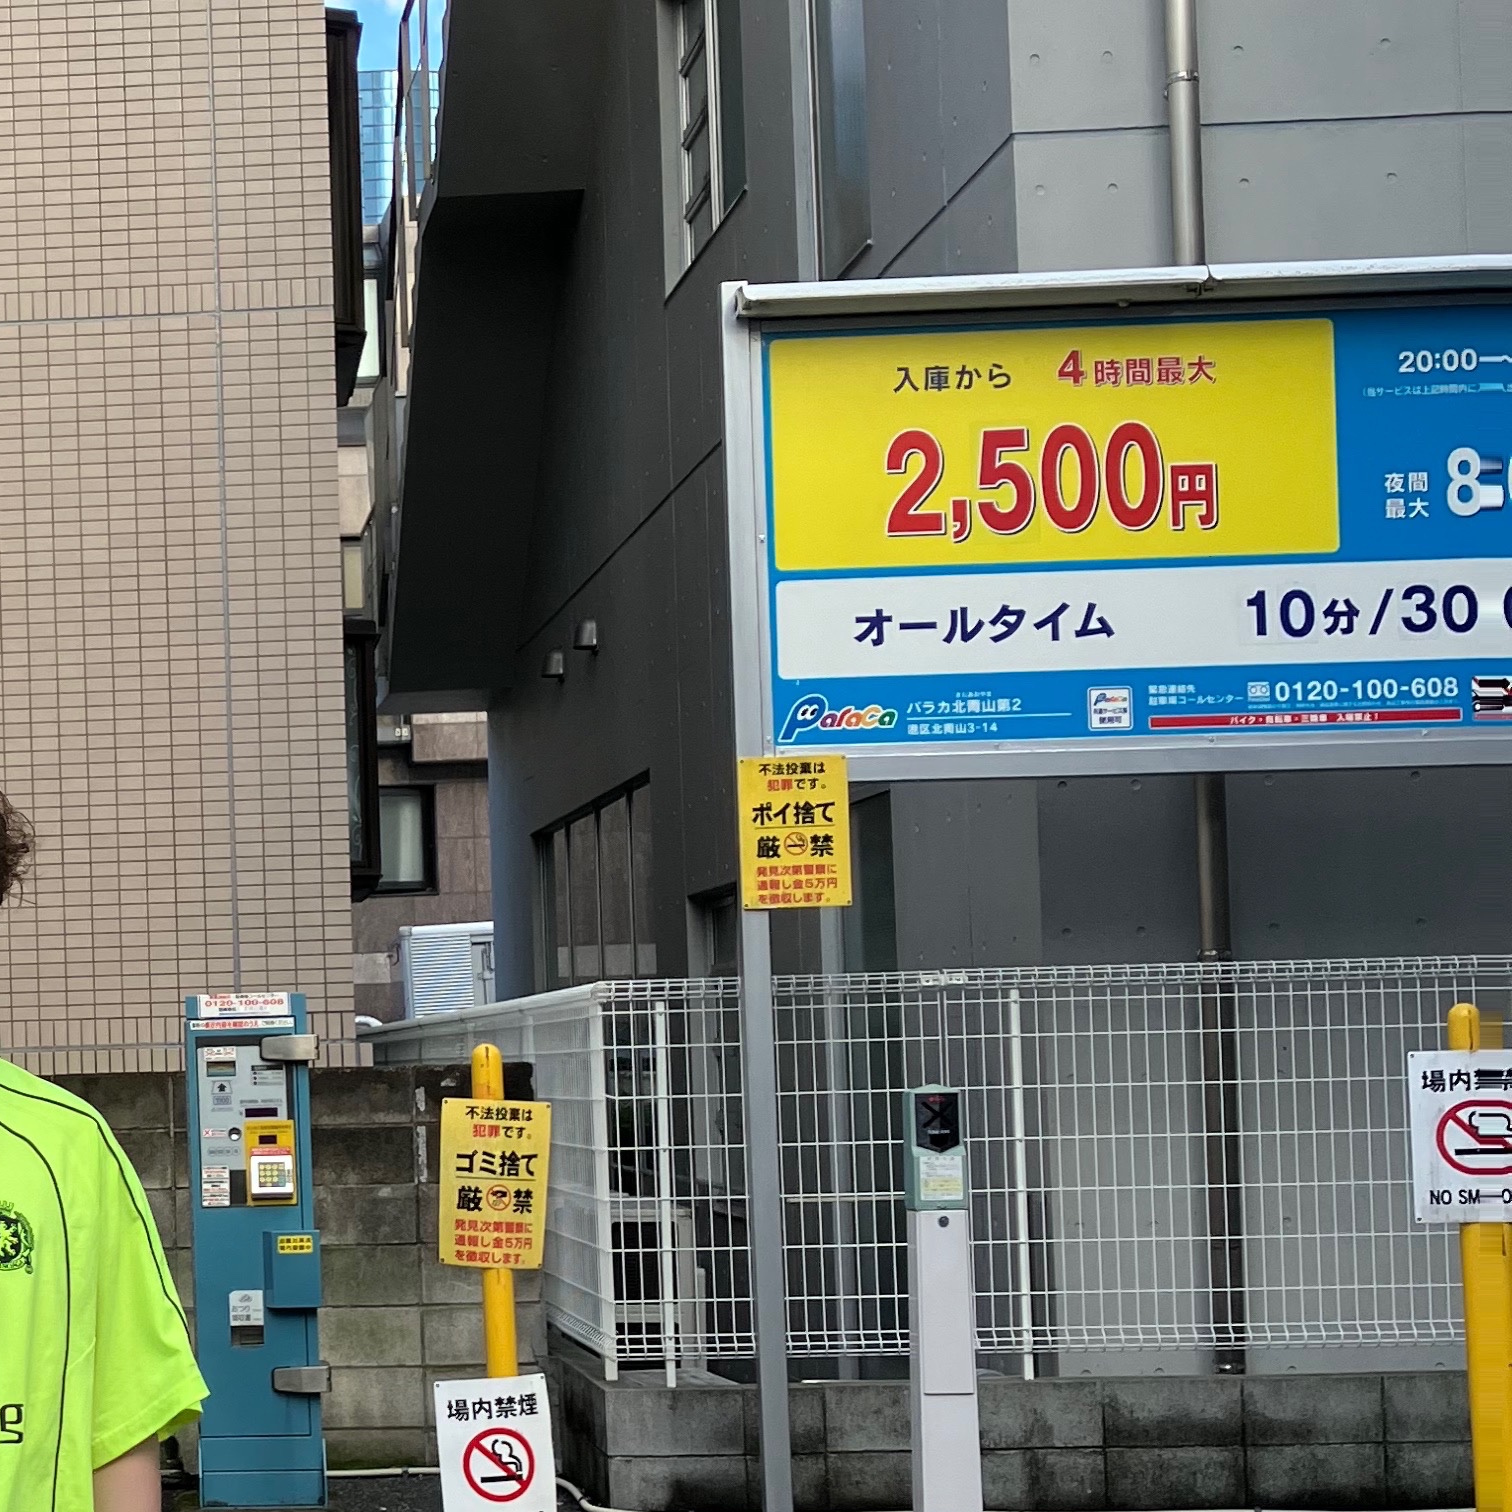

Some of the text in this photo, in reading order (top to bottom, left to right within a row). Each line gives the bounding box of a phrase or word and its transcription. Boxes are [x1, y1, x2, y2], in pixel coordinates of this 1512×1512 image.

[893, 363, 1012, 393] 入庫から
[886, 421, 1220, 543] 2,500円
[1384, 471, 1429, 493] 夜間
[1384, 497, 1430, 519] 最大
[853, 602, 1115, 647] オールタイム
[1274, 676, 1459, 702] 0120-100-608
[906, 697, 1022, 715] パラカ北青山第2
[758, 761, 826, 776] 不法投棄は
[767, 777, 827, 792] 犯罪です。
[752, 801, 835, 826] ポイ捨て
[465, 1105, 533, 1122] 不法投棄は
[472, 1123, 532, 1140] 犯罪です。
[455, 1150, 539, 1177] ゴミ捨て
[1429, 1190, 1452, 1205] NO
[447, 1392, 539, 1421] 場内禁煙
